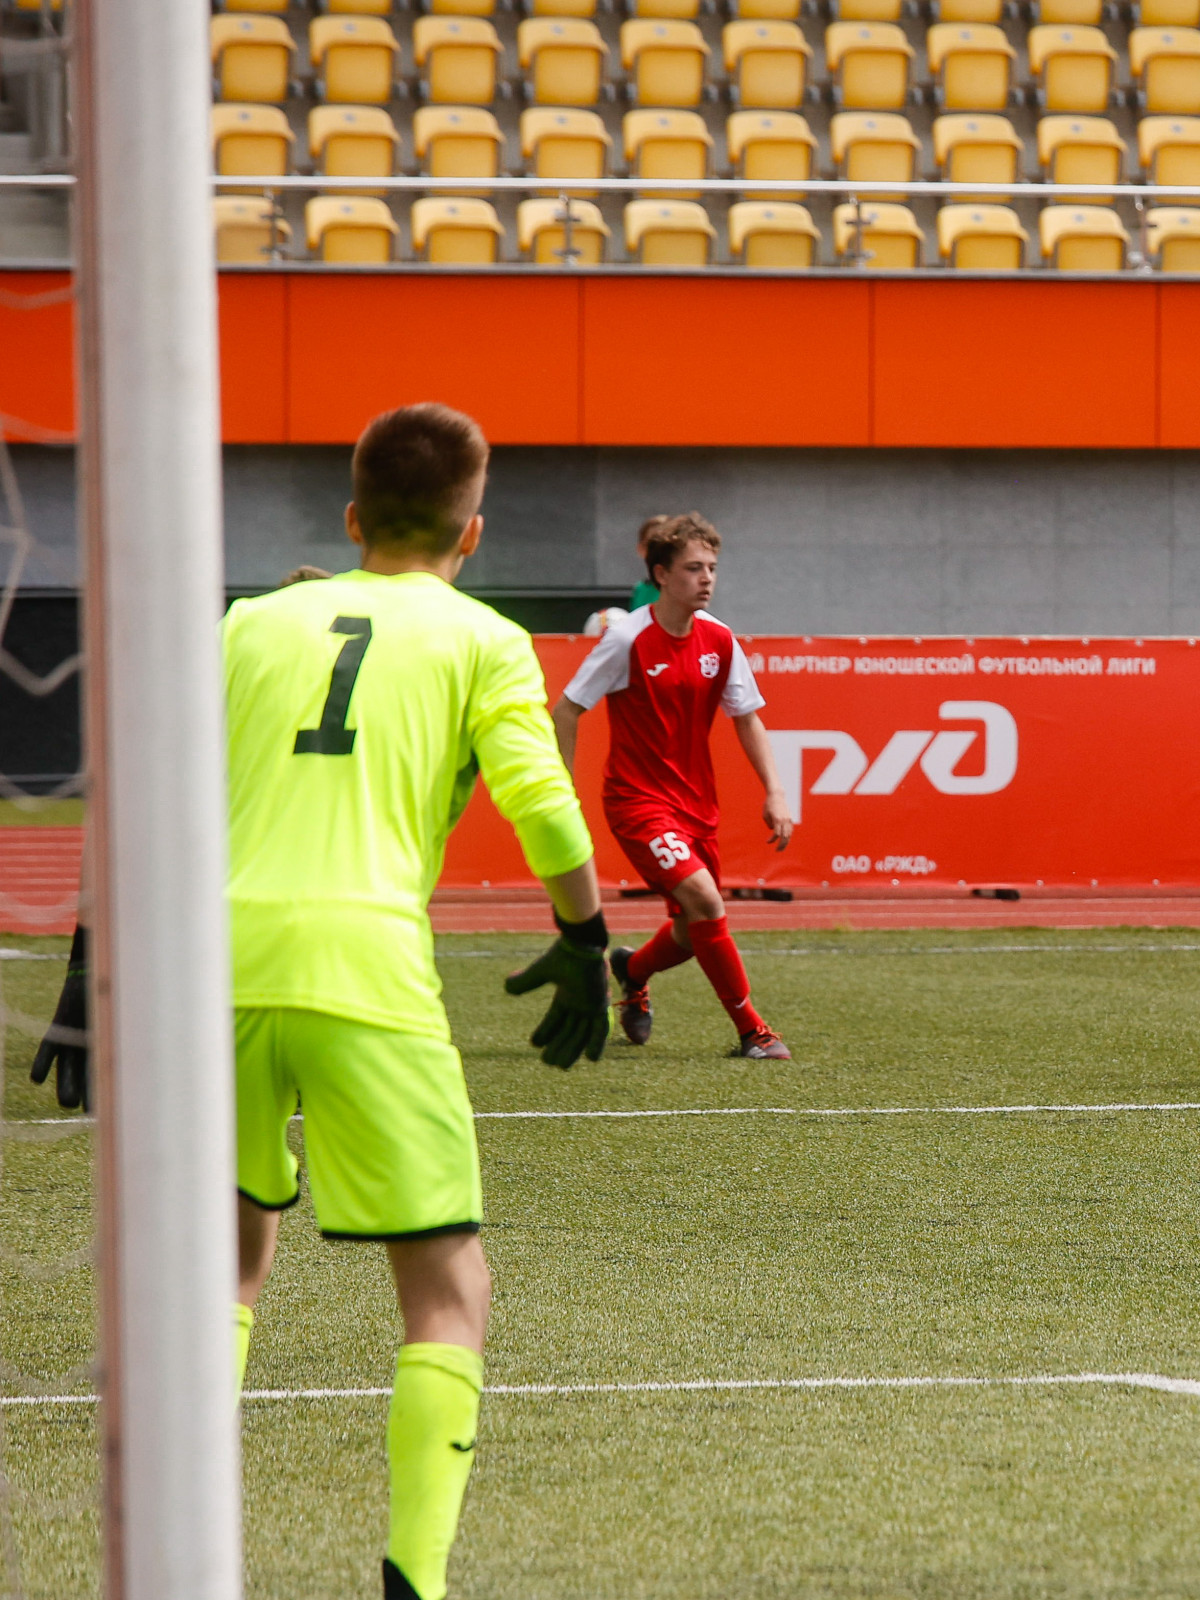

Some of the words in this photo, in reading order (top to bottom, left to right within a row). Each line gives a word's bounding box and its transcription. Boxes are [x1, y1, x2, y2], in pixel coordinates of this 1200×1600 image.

[768, 655, 852, 673] ПАРТНЕР
[854, 654, 975, 675] ЮНОШЕСКОЙ
[978, 655, 1103, 675] ФУТБОЛЬНОЙ
[1106, 657, 1156, 675] ЛИГИ
[293, 616, 372, 755] 1
[649, 831, 690, 870] 55
[831, 855, 870, 873] ОАО
[875, 856, 936, 874] «РЖД»
